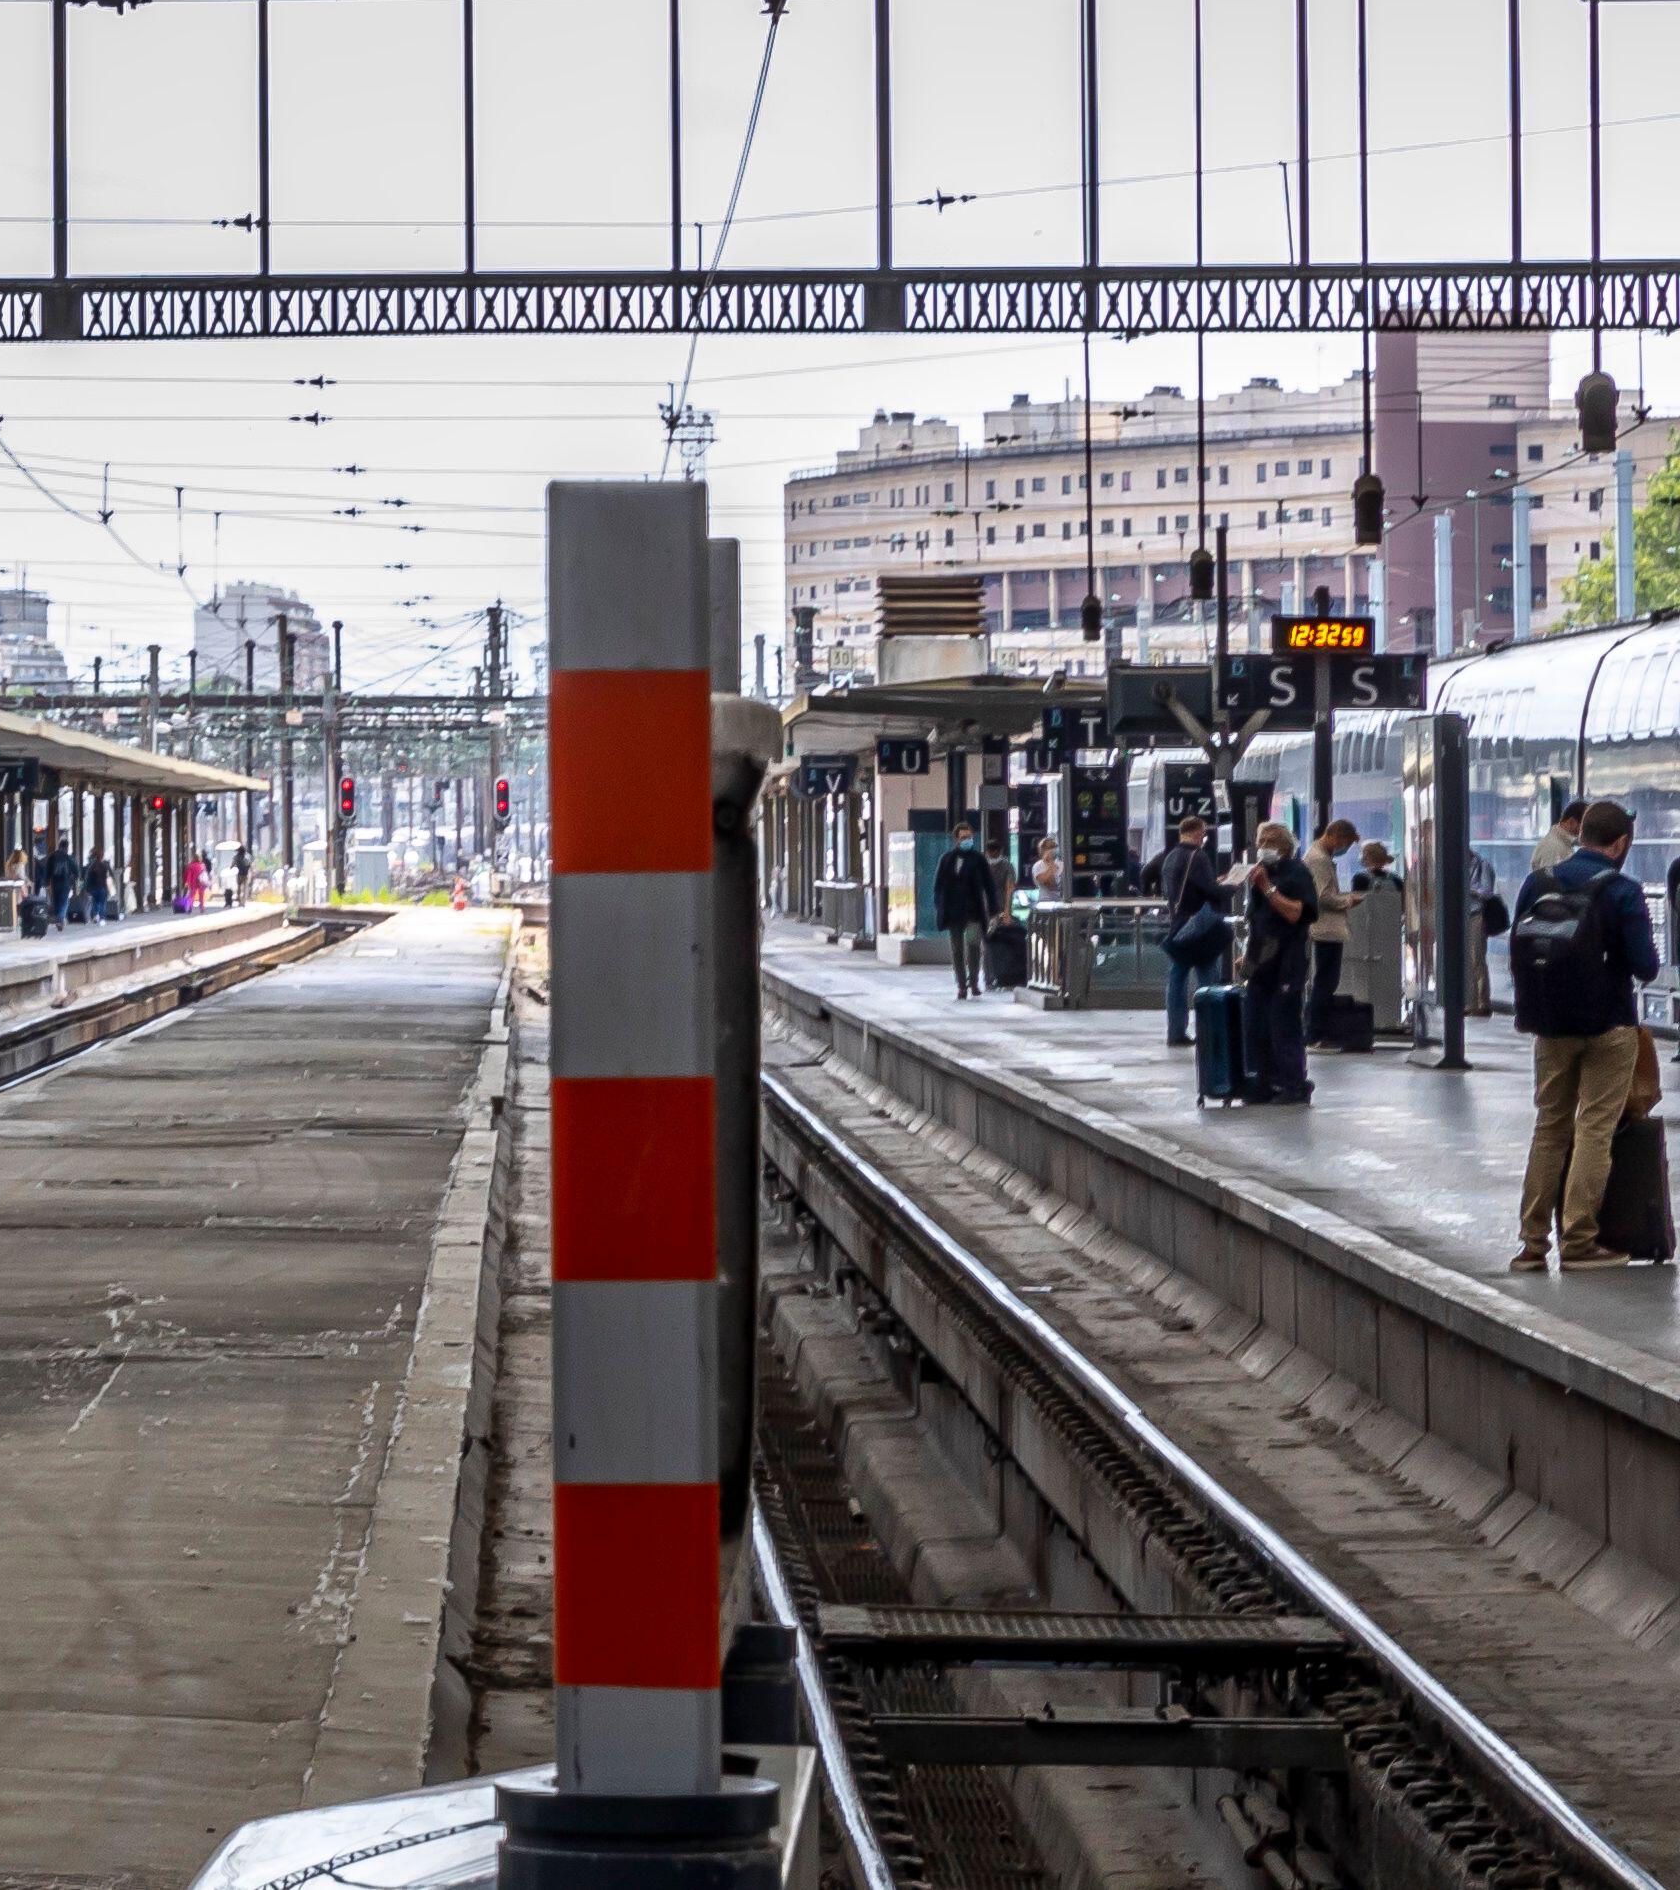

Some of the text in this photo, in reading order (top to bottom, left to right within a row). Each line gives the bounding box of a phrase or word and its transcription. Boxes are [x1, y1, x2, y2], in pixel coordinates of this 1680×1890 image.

[1268, 665, 1296, 707] S
[1351, 666, 1379, 706] S
[1079, 717, 1102, 746] T
[901, 749, 921, 773] U
[825, 773, 842, 794] V
[1169, 797, 1184, 815] U
[1197, 797, 1211, 815] Z
